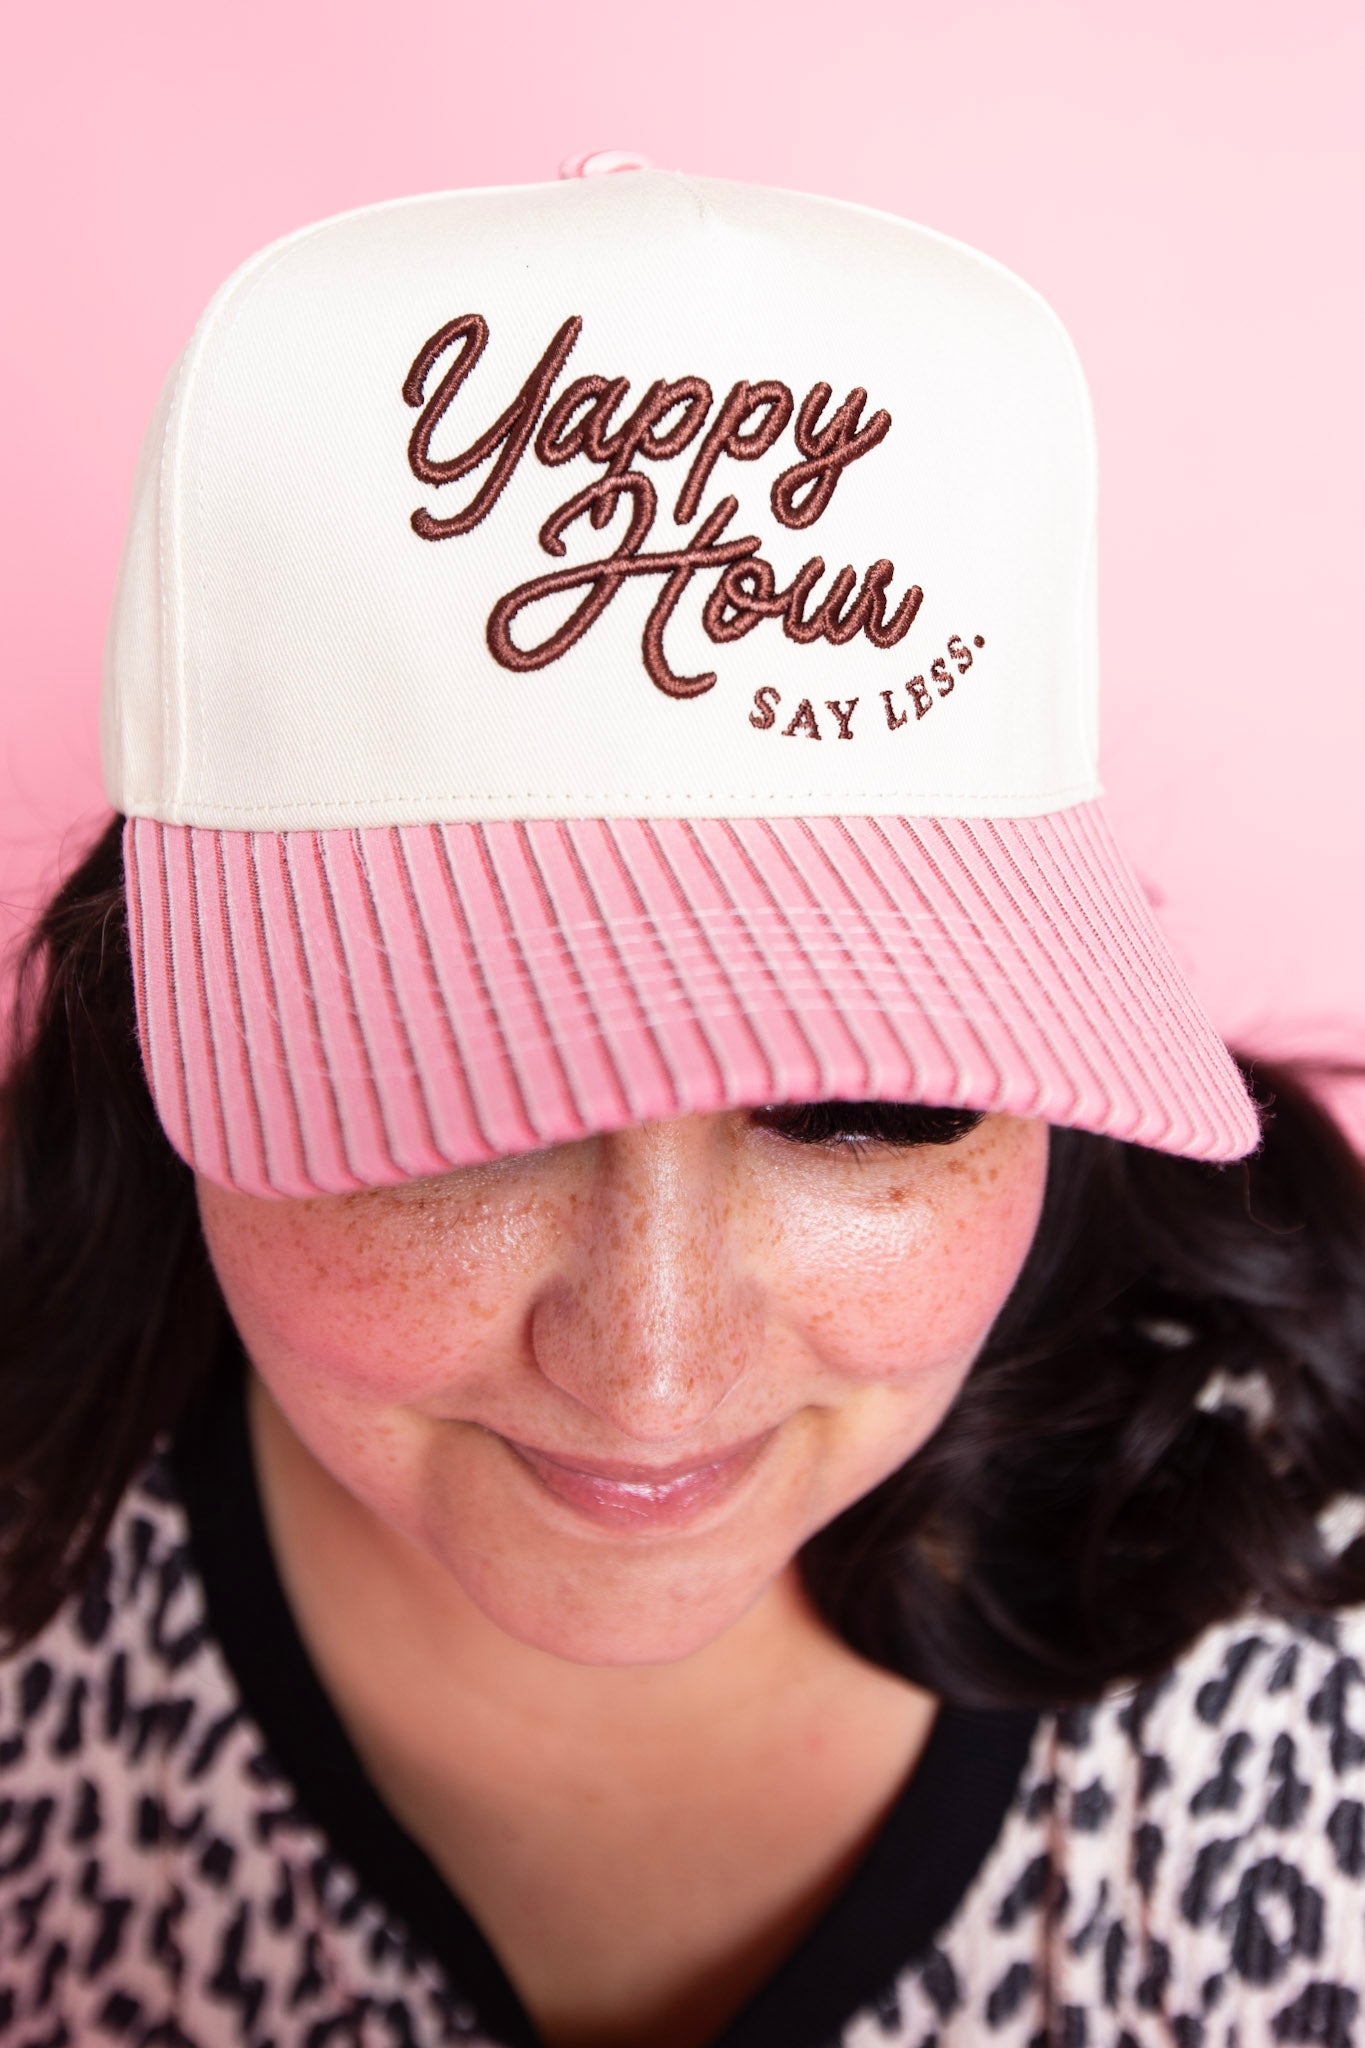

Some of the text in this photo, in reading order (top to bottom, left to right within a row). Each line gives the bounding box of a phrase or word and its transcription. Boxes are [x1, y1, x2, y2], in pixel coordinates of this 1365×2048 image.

[401, 313, 893, 542] Yappy
[485, 470, 924, 700] Hour
[748, 634, 987, 741] SAY LESS.
